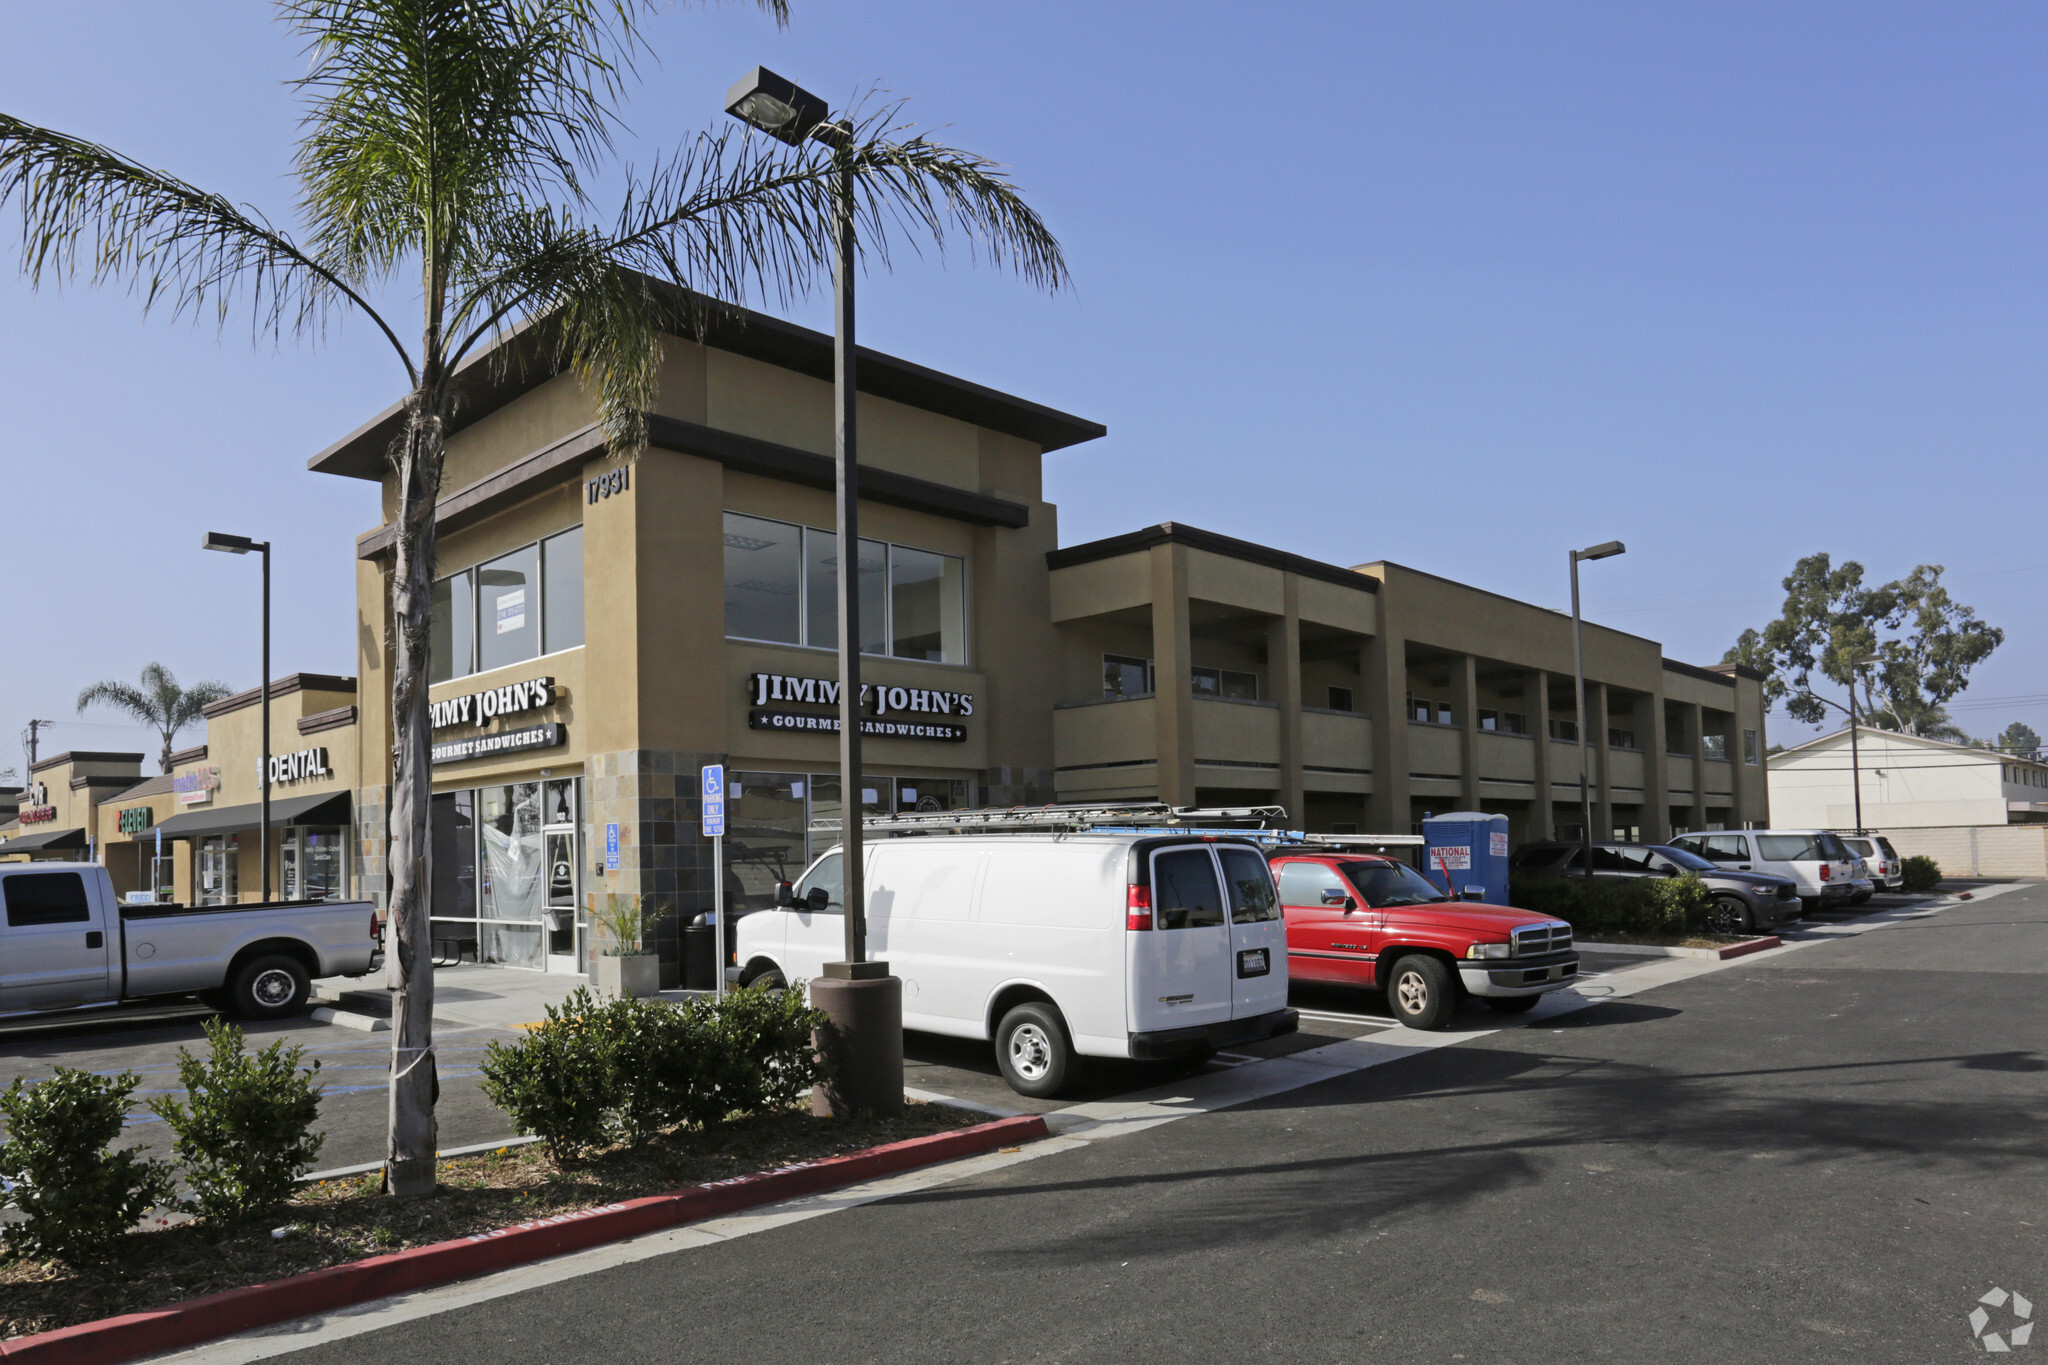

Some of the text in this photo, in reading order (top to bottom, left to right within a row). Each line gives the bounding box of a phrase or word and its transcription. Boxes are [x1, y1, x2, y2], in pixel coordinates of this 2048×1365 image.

[585, 465, 629, 505] 17931
[429, 677, 547, 729] MMY JOHN'S
[876, 685, 973, 716] JOHN'S
[773, 715, 840, 730] GOURME
[475, 729, 544, 752] SANDWICHES
[269, 747, 326, 783] DENTAL
[704, 793, 722, 804] PARKING
[556, 811, 566, 820] 102
[707, 804, 719, 815] ONLY
[1430, 847, 1470, 856] NATIONAL
